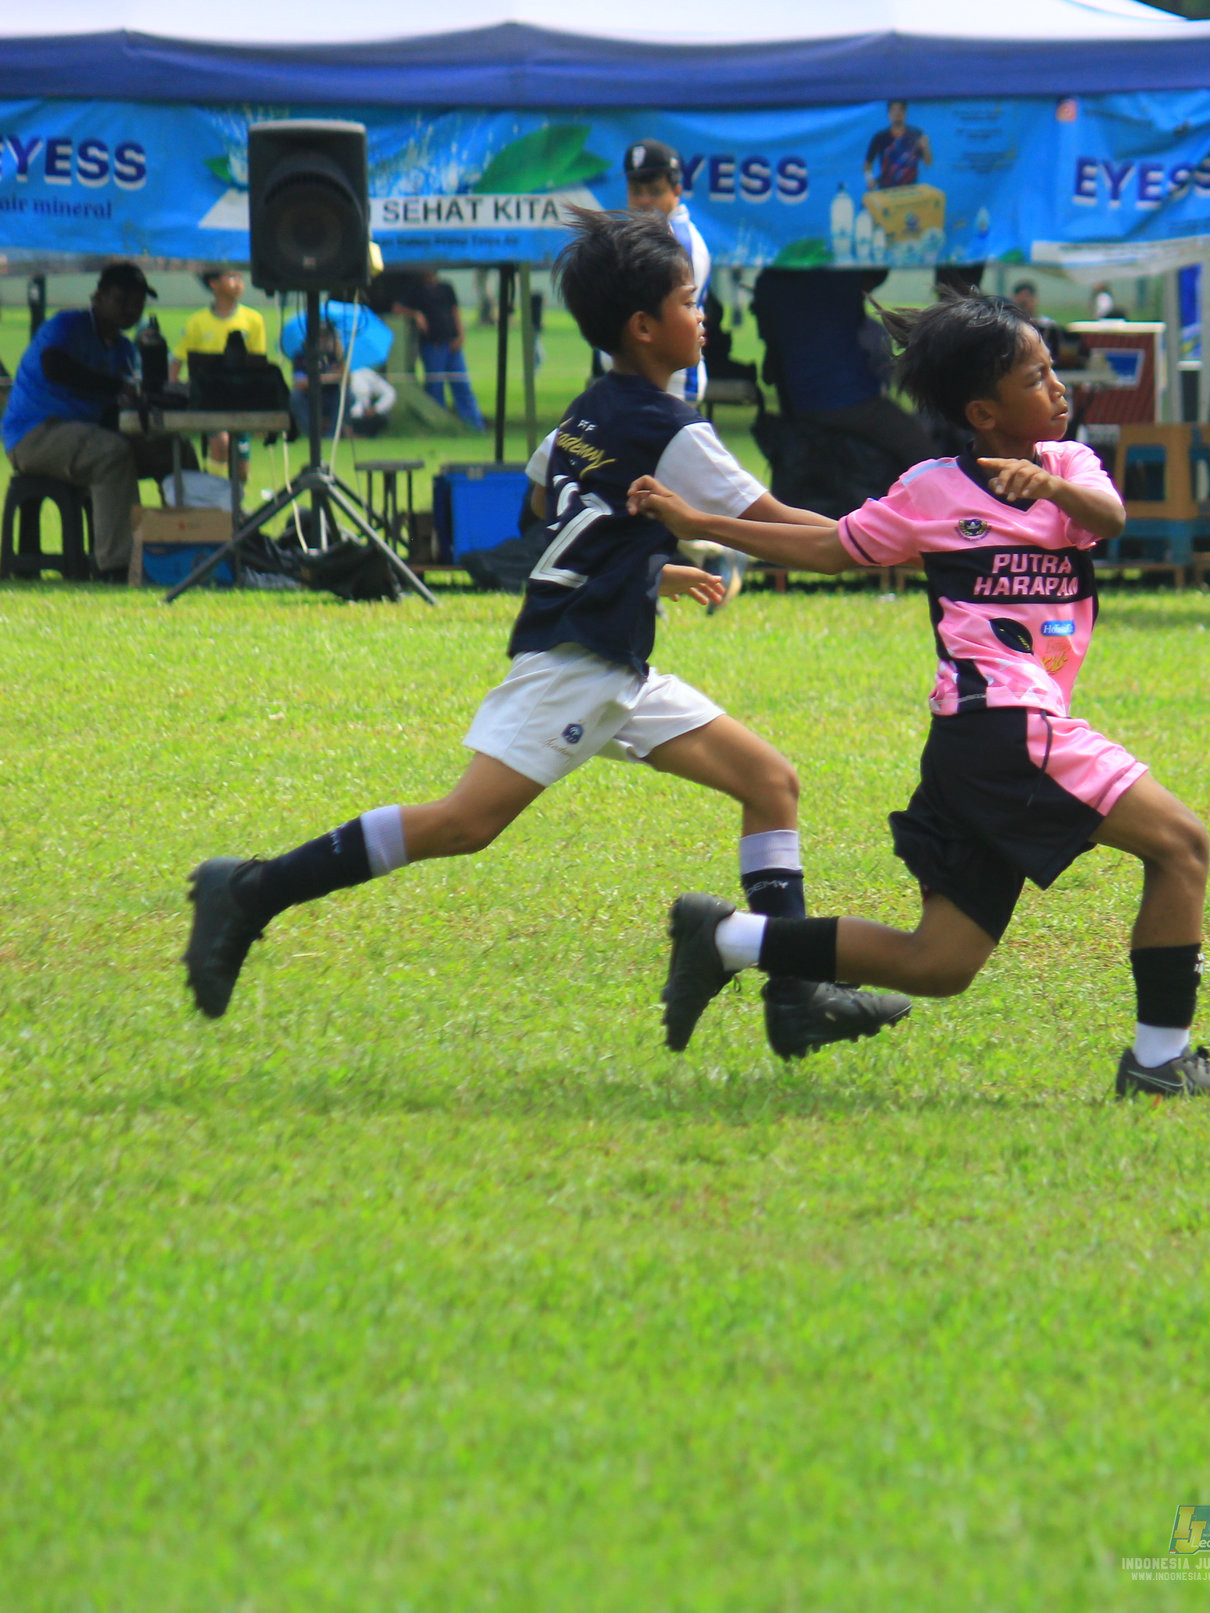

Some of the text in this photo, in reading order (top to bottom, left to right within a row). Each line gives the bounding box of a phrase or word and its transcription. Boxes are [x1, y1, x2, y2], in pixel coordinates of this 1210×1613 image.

[0, 136, 147, 190] YESS
[680, 153, 809, 203] YESS
[33, 197, 112, 219] mineral
[383, 196, 560, 223] SEHAT KITA
[991, 553, 1073, 574] PUTRA
